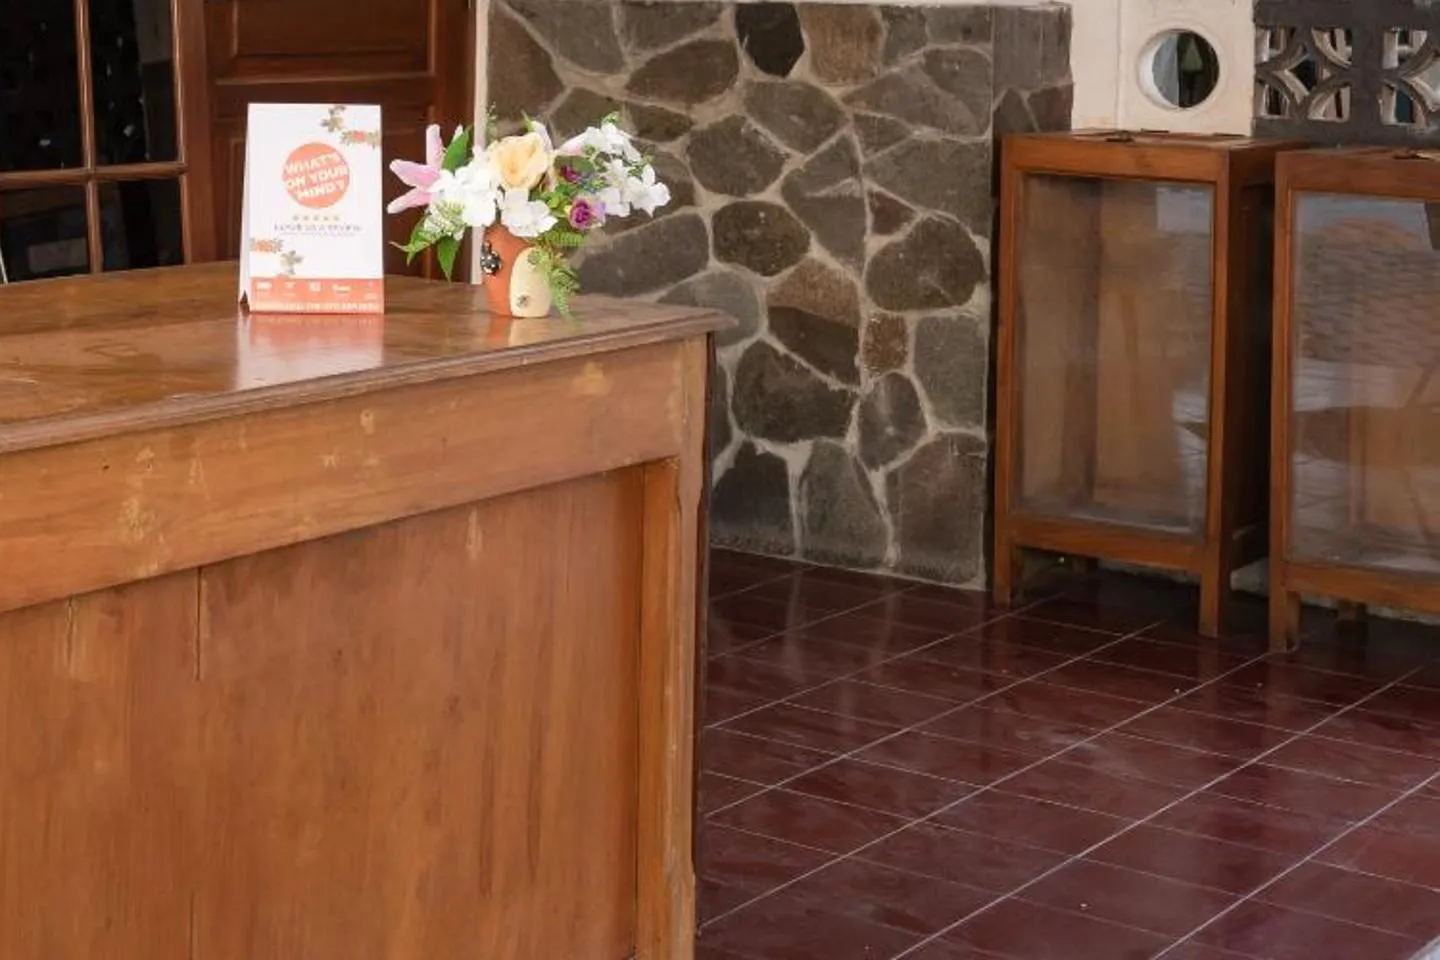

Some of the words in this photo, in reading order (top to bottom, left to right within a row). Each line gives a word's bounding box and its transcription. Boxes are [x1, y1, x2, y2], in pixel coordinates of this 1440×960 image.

[285, 153, 341, 174] WHAT'S
[285, 177, 307, 191] ON
[309, 164, 349, 186] YOUR
[295, 179, 345, 201] MIND?
